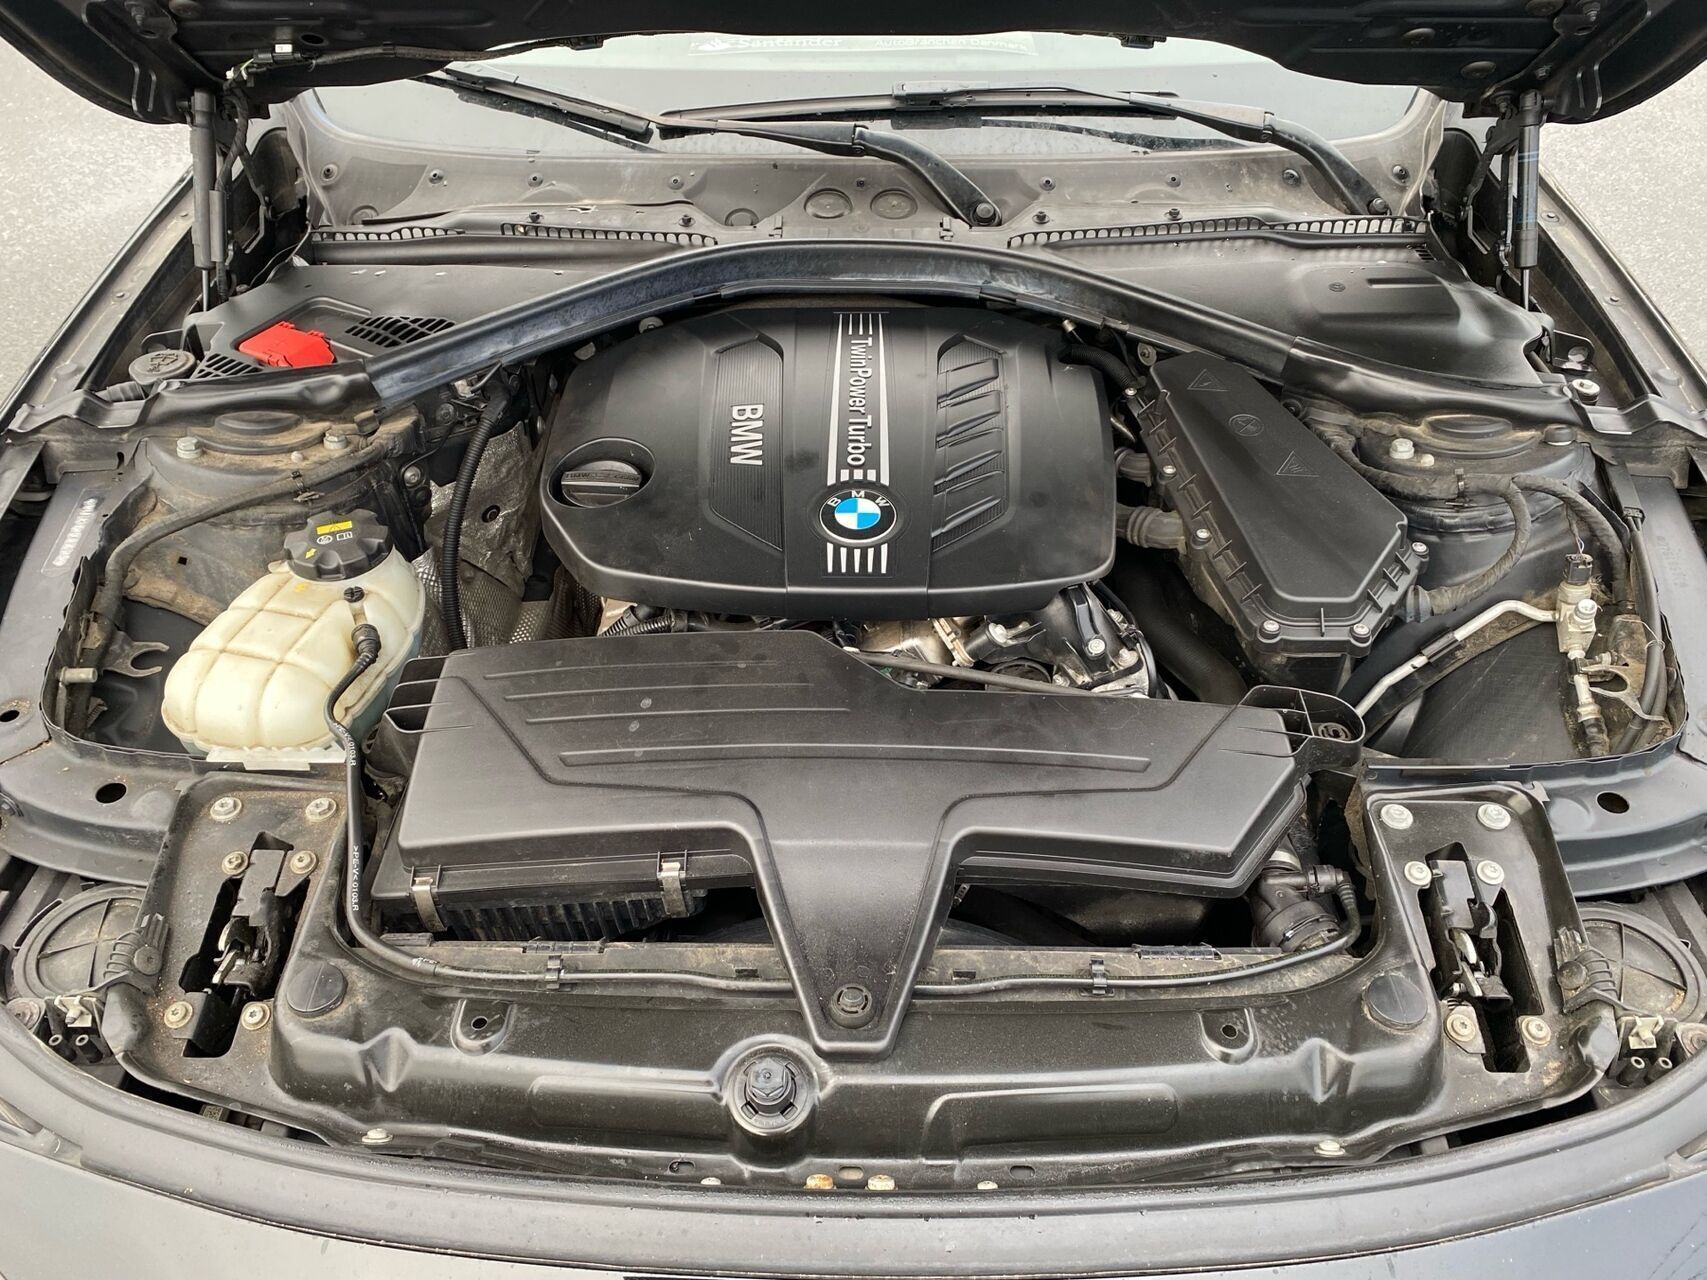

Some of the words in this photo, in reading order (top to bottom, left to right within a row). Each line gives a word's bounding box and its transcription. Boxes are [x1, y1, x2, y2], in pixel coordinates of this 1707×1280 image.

[736, 36, 843, 49] Santander
[848, 337, 873, 413] TwinPower
[730, 403, 764, 466] BMW
[846, 415, 872, 466] Turbo
[827, 490, 890, 508] BMW
